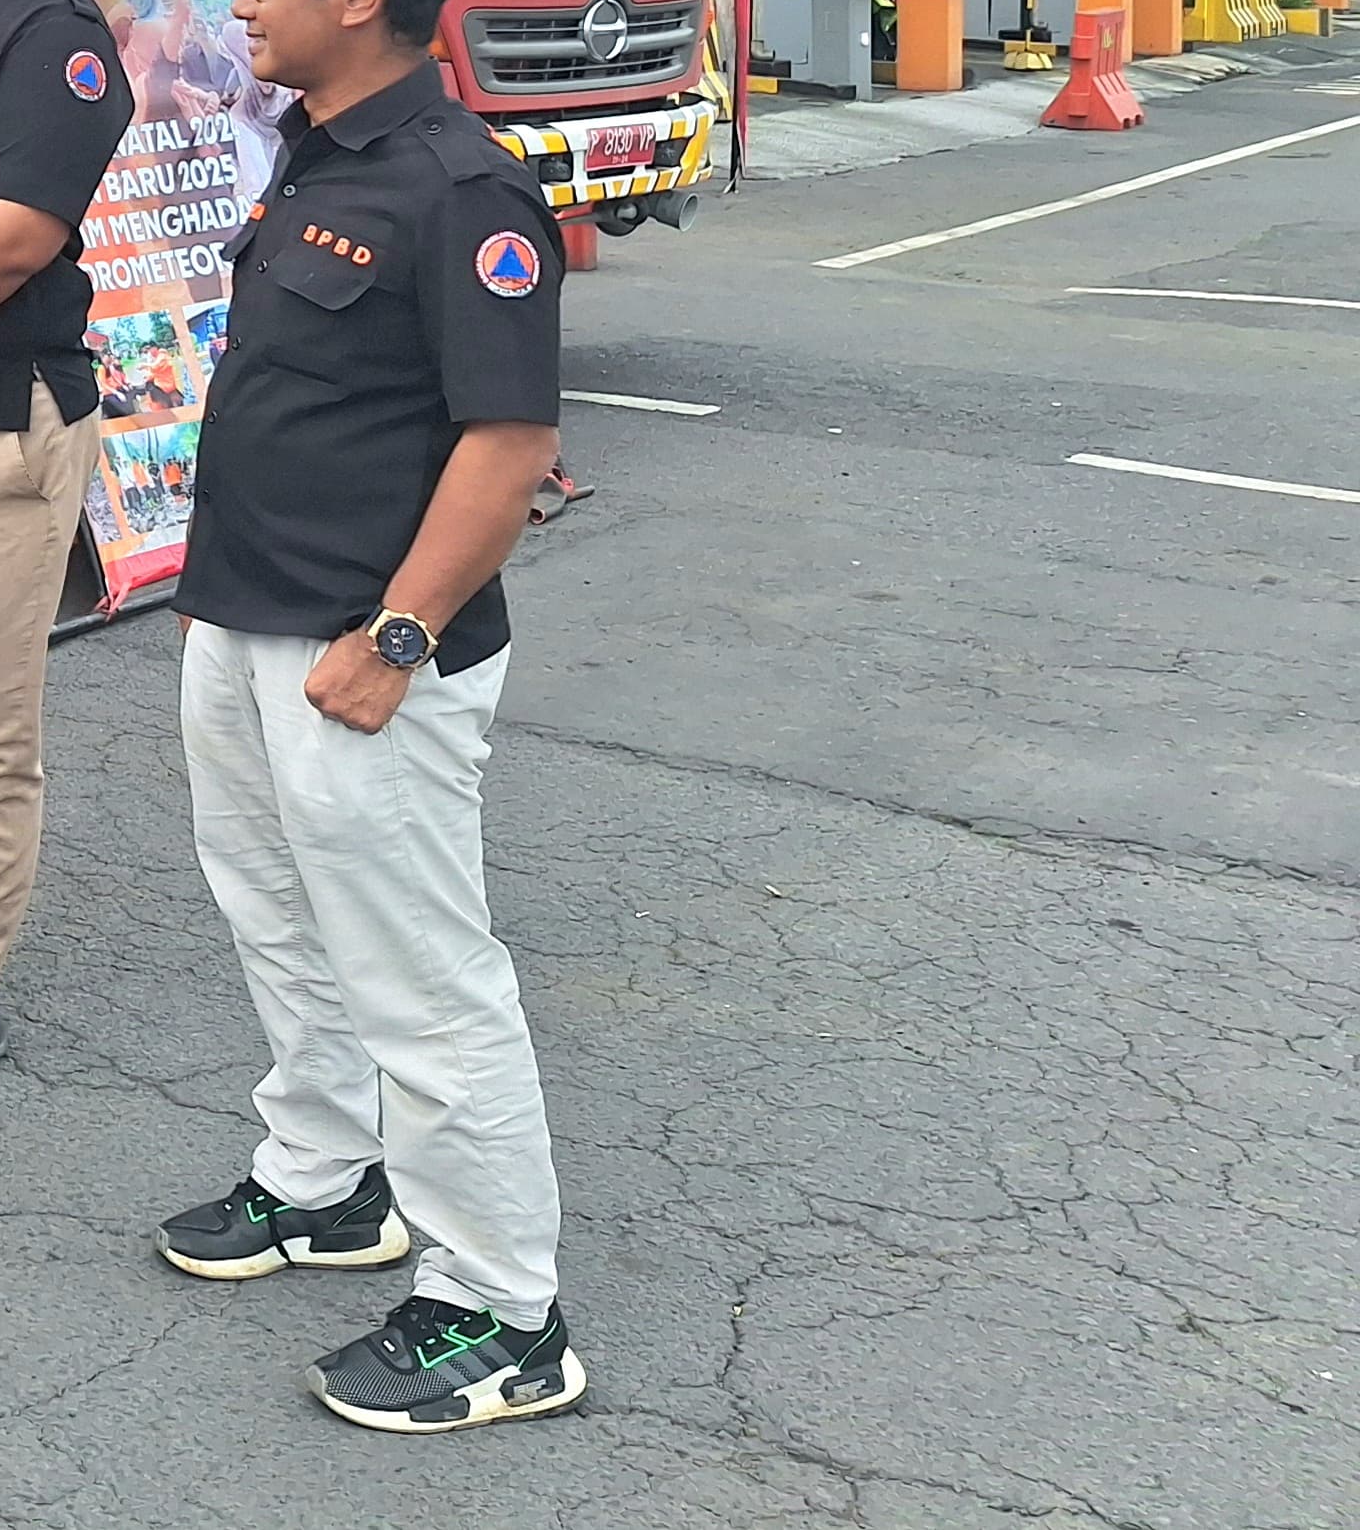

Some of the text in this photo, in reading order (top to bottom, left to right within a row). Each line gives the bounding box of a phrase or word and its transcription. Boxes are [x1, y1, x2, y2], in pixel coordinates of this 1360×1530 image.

[589, 125, 655, 156] P 8130 VP
[103, 163, 175, 203] BARU
[178, 153, 239, 193] 2025
[302, 223, 373, 266] BPBD
